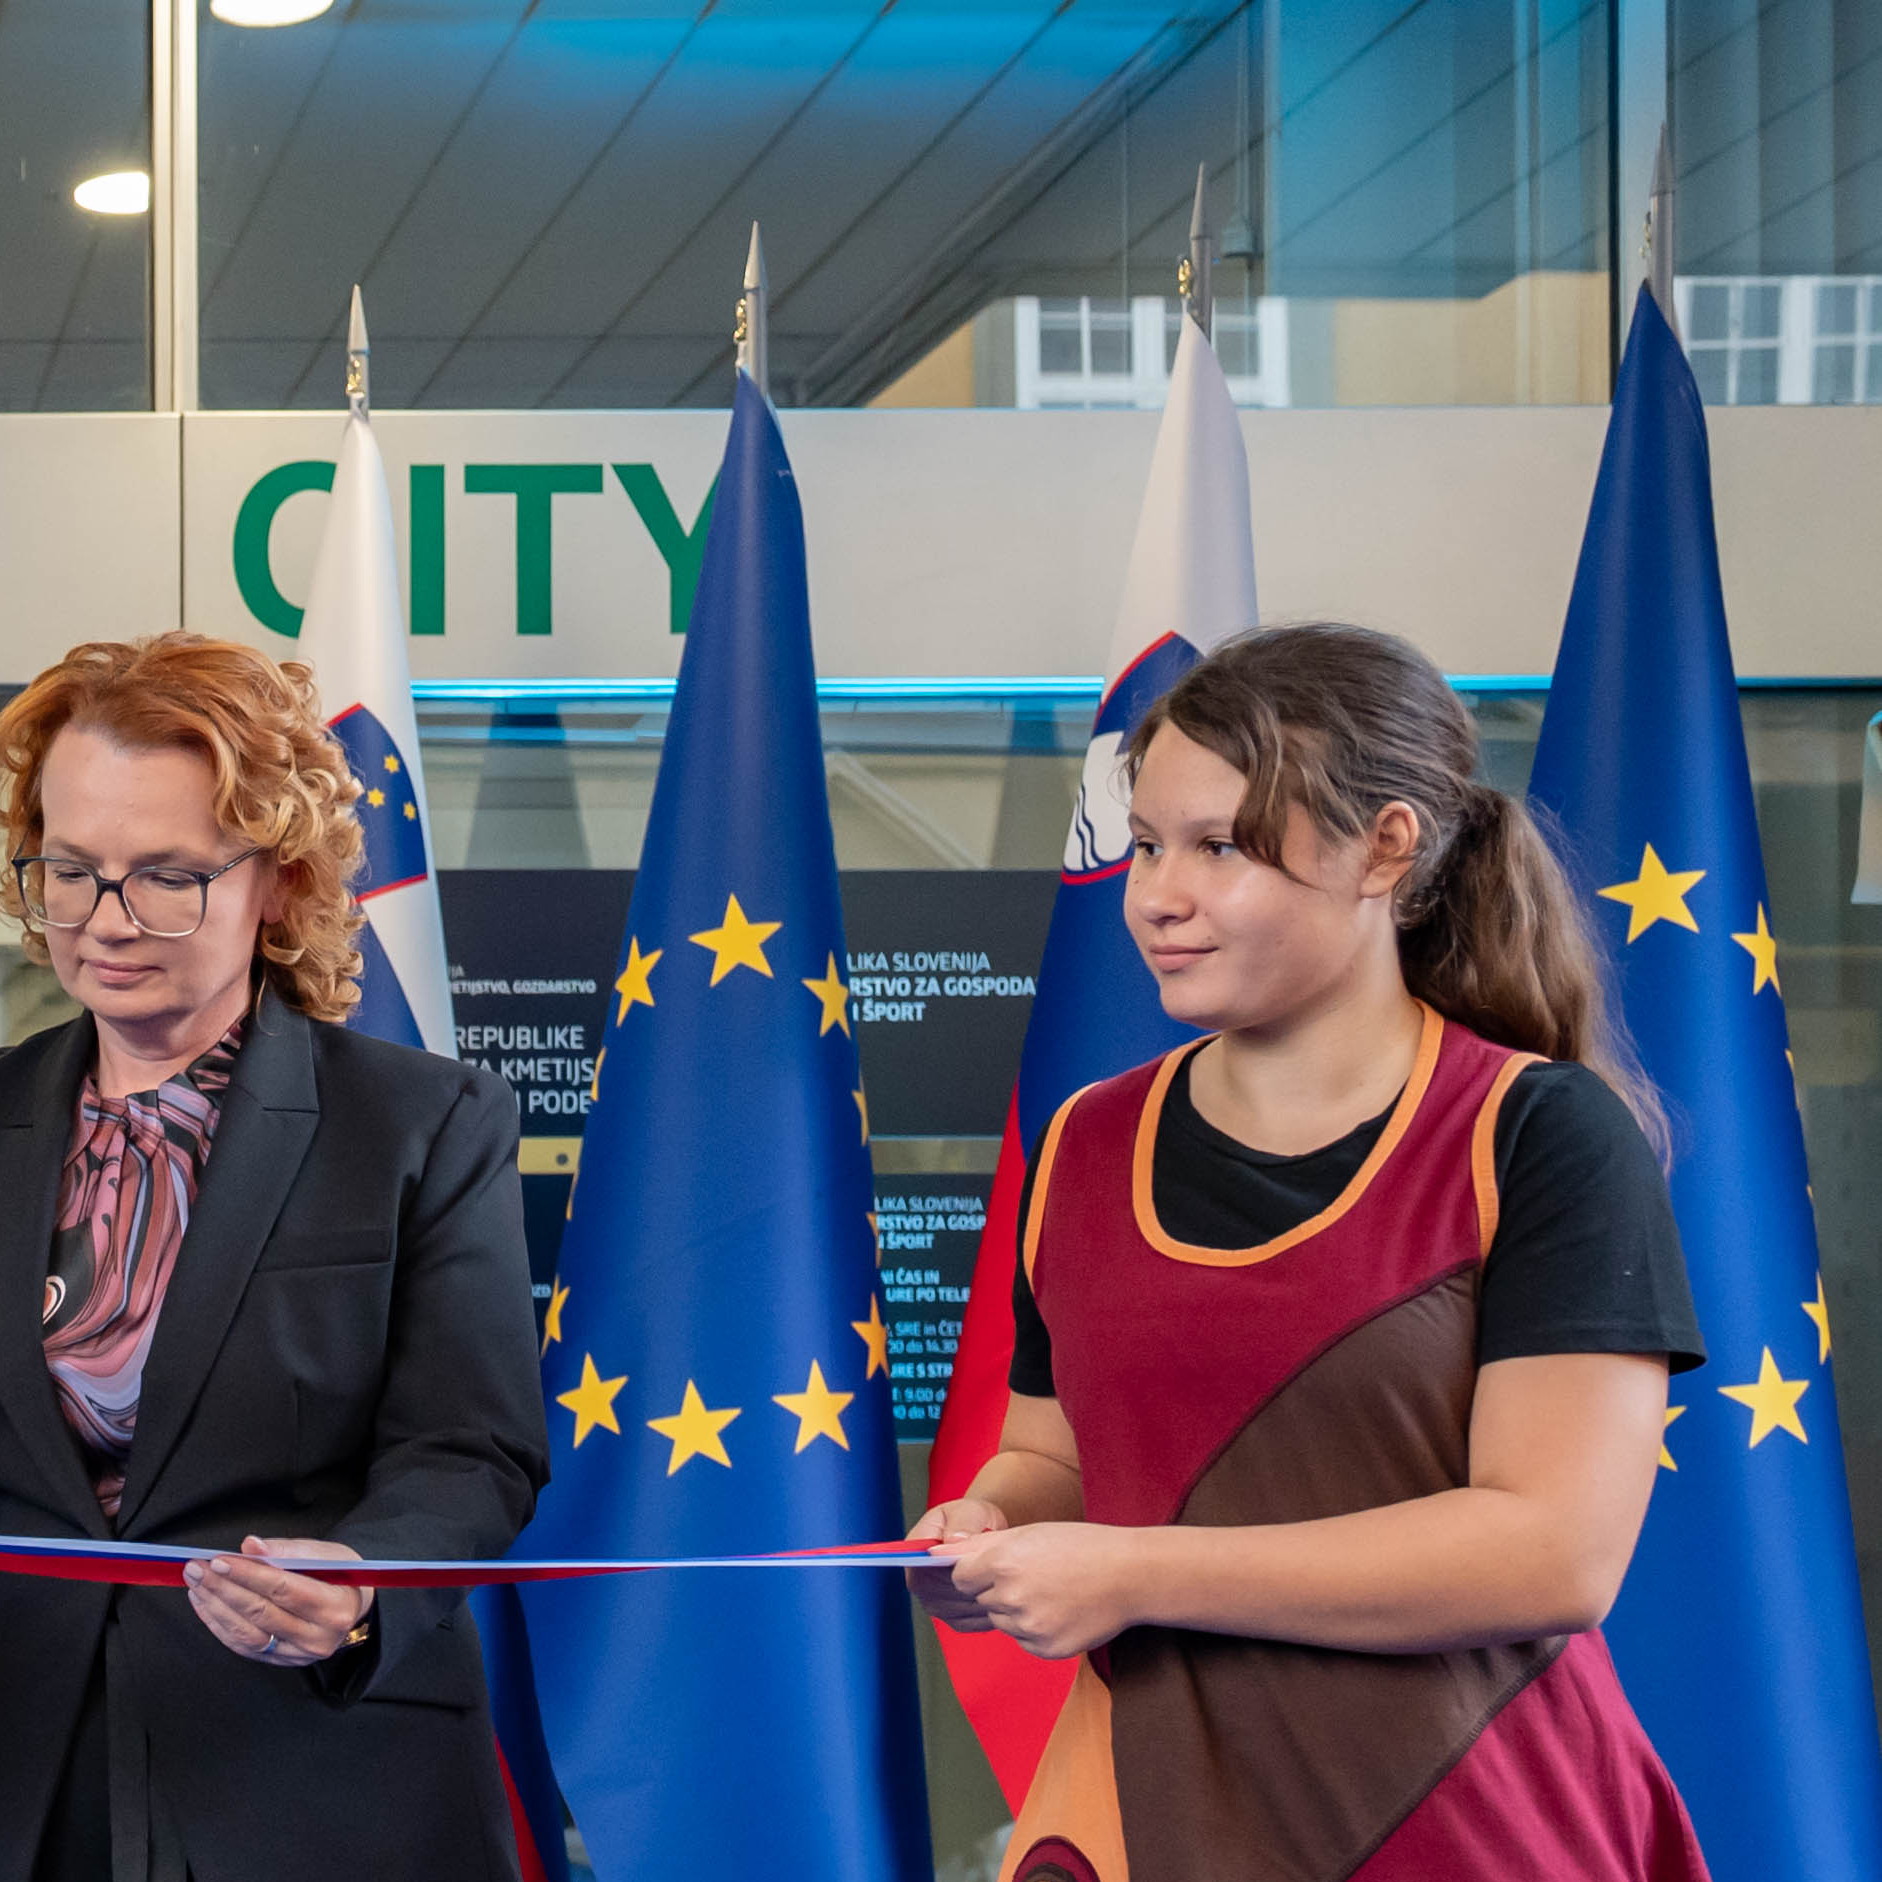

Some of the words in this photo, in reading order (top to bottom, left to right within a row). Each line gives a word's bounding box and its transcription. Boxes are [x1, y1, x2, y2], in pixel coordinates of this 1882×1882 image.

[232, 460, 723, 636] CITY
[846, 951, 889, 972] LIKA
[892, 951, 992, 975] SLOVENIJA
[451, 979, 511, 996] ETIJSTVO,
[512, 979, 597, 994] GOZDARSTVO
[848, 975, 911, 997] RSTVO
[914, 976, 941, 997] ZA
[943, 976, 1037, 997] GOSPODA
[861, 997, 927, 1022] ŠPORT
[455, 1025, 585, 1050] REPUBLIKE
[500, 1057, 595, 1086] KMETIJS
[528, 1089, 591, 1114] PODE
[874, 1196, 907, 1212] LIKA
[908, 1195, 984, 1214] SLOVENIJA
[876, 1213, 924, 1231] RSTVO
[925, 1213, 946, 1231] ZA
[947, 1213, 987, 1231] GOSP
[886, 1231, 935, 1249] ŠPORT
[896, 1266, 923, 1285] ČAS
[915, 1286, 936, 1303] PO
[937, 1286, 971, 1303] TELE
